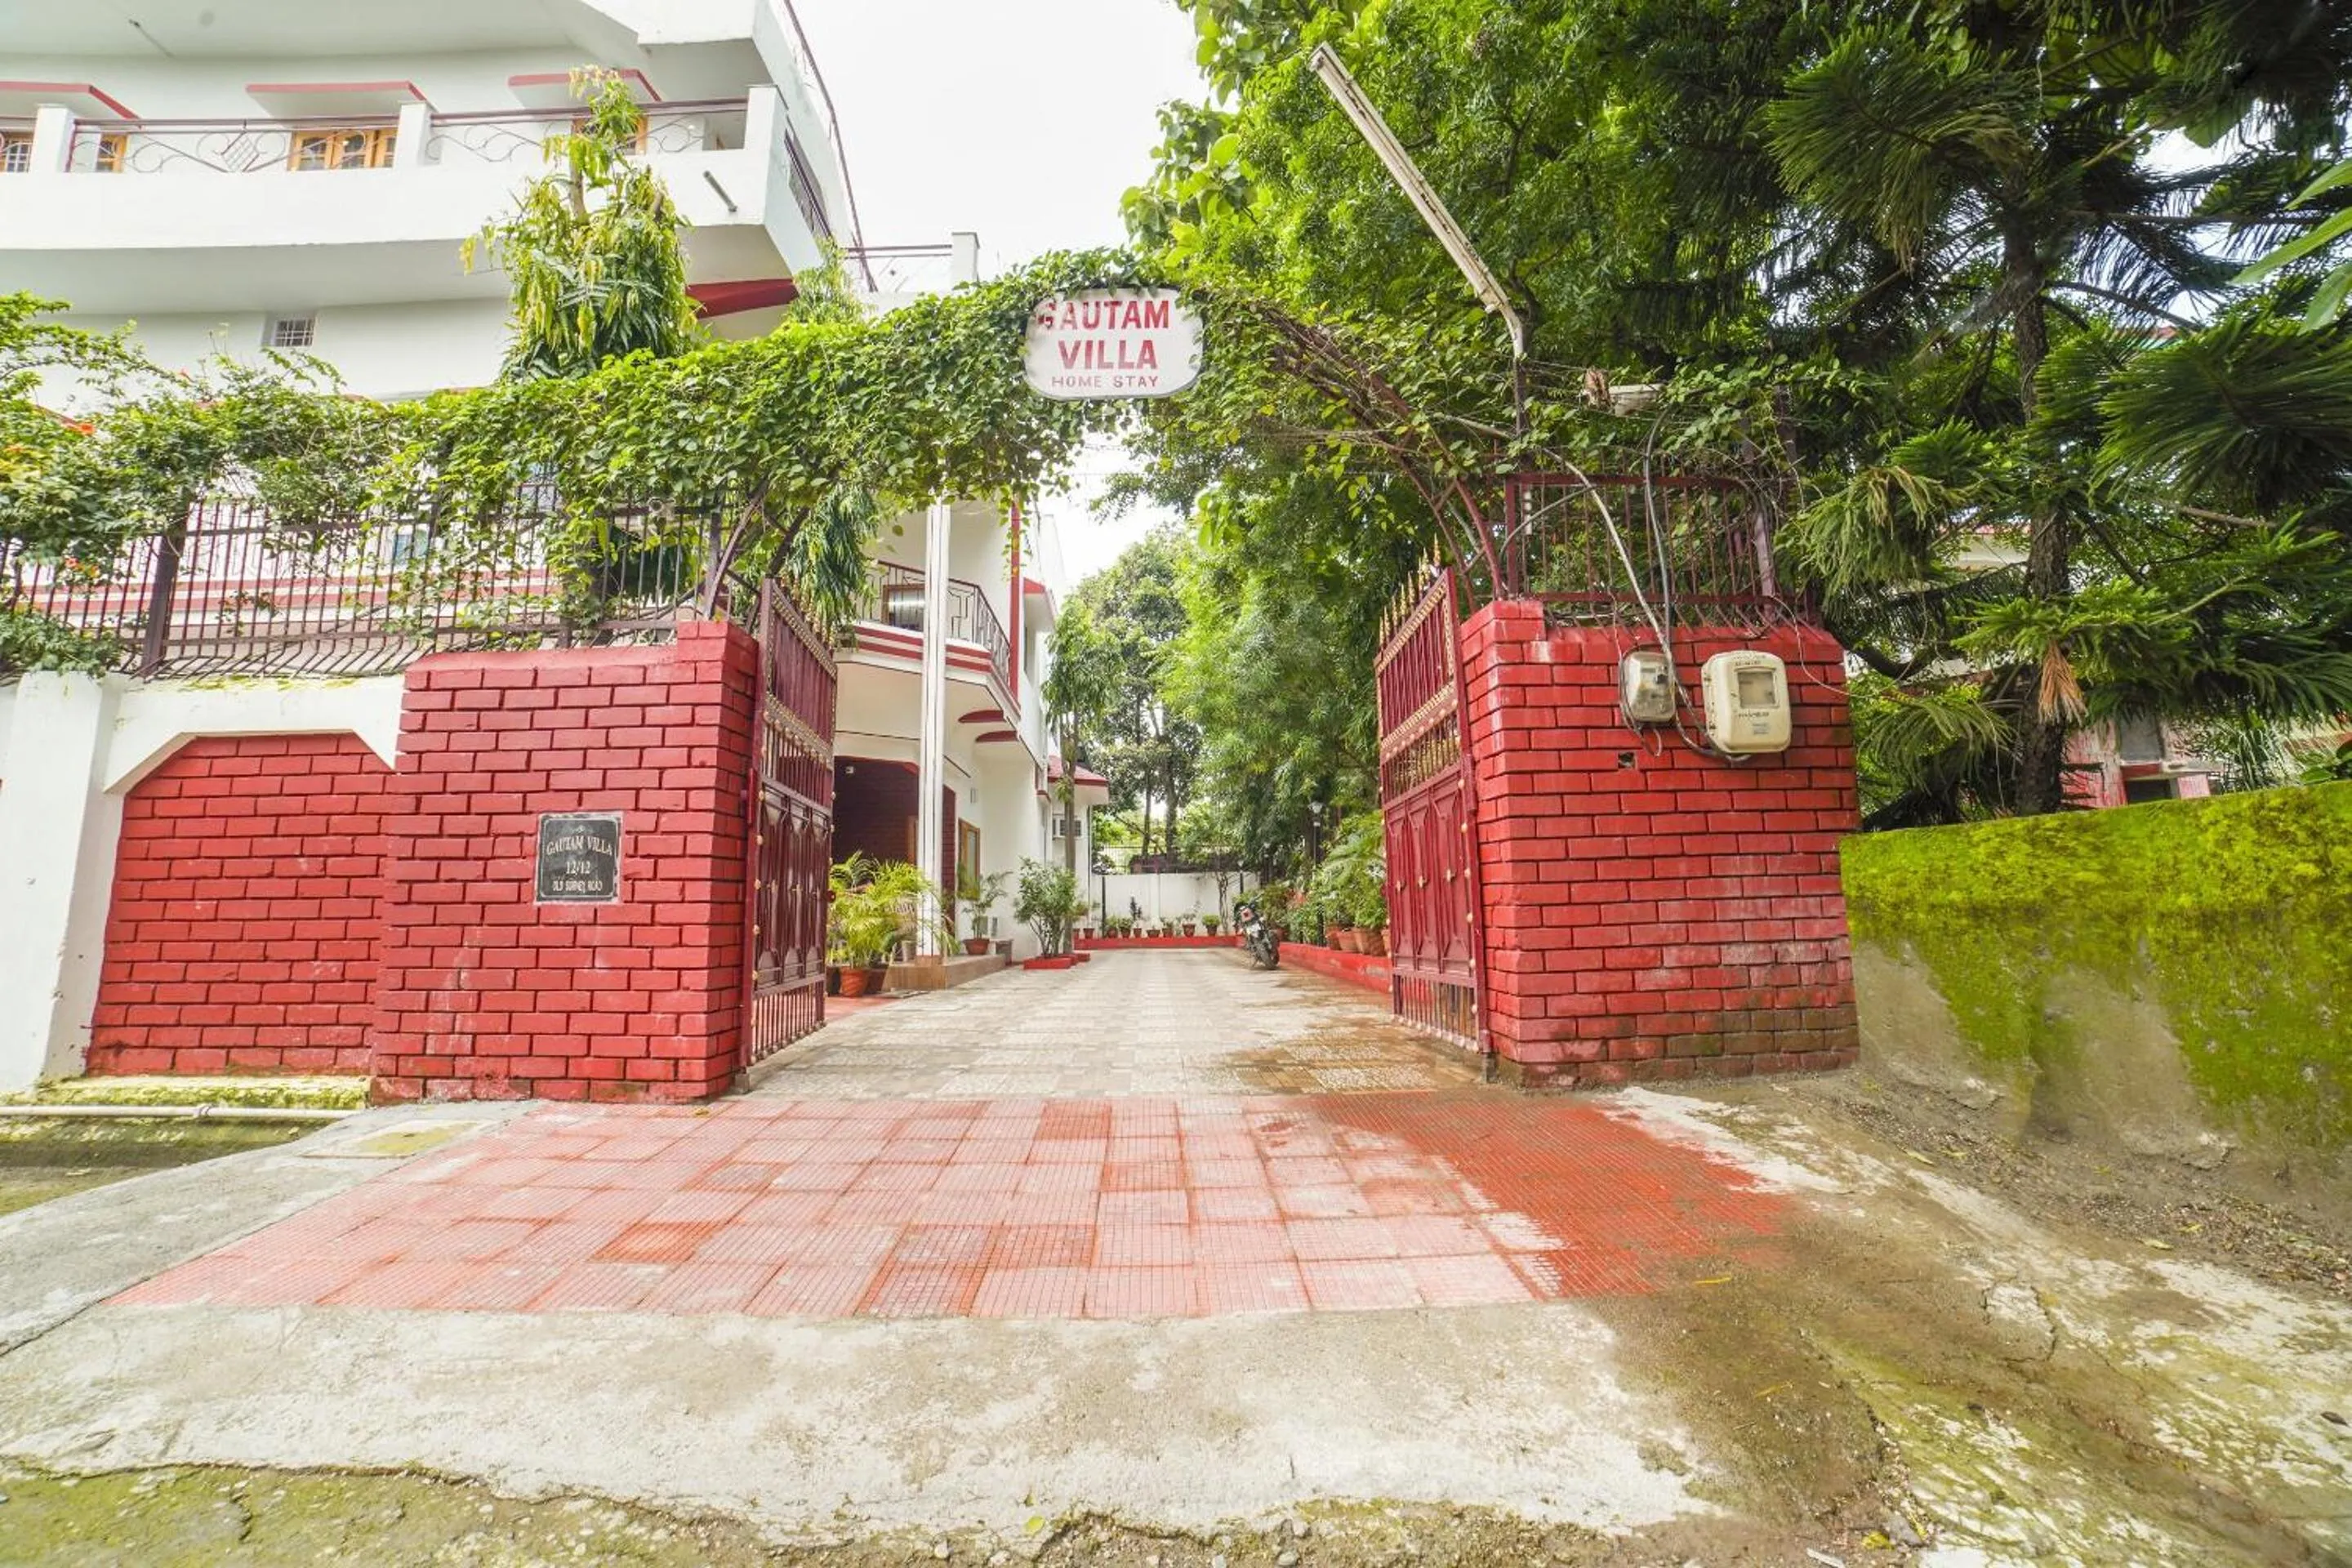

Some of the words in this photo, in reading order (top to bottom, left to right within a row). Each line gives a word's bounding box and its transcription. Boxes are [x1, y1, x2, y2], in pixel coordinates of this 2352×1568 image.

[1058, 339, 1158, 369] VILLA
[1051, 375, 1102, 388] HOME
[1112, 375, 1159, 388] STAY
[546, 835, 585, 855] GAUTAM
[586, 835, 612, 856] VILLA
[565, 860, 590, 875] 12/12
